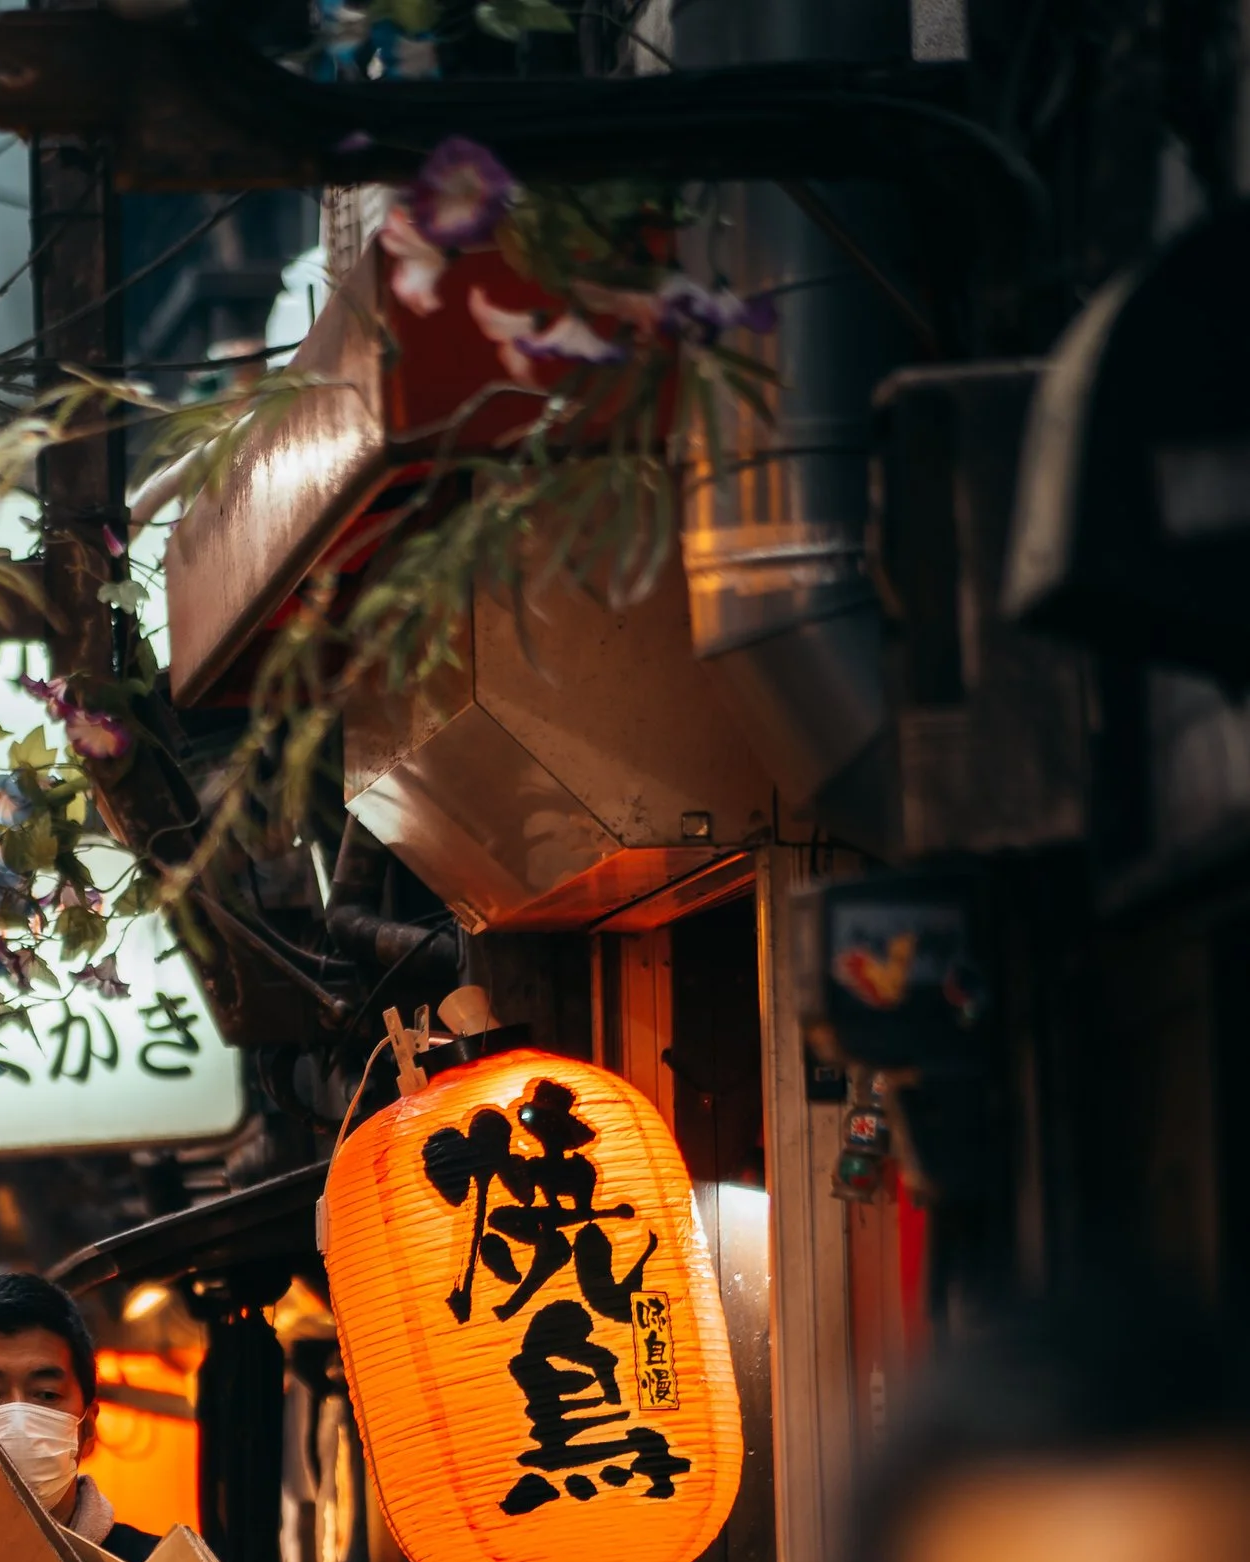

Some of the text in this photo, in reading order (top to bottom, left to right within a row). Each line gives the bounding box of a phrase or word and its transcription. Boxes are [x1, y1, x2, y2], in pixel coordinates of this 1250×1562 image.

[422, 1079, 692, 1517] 焼鳥
[636, 1297, 675, 1405] 味自慢
